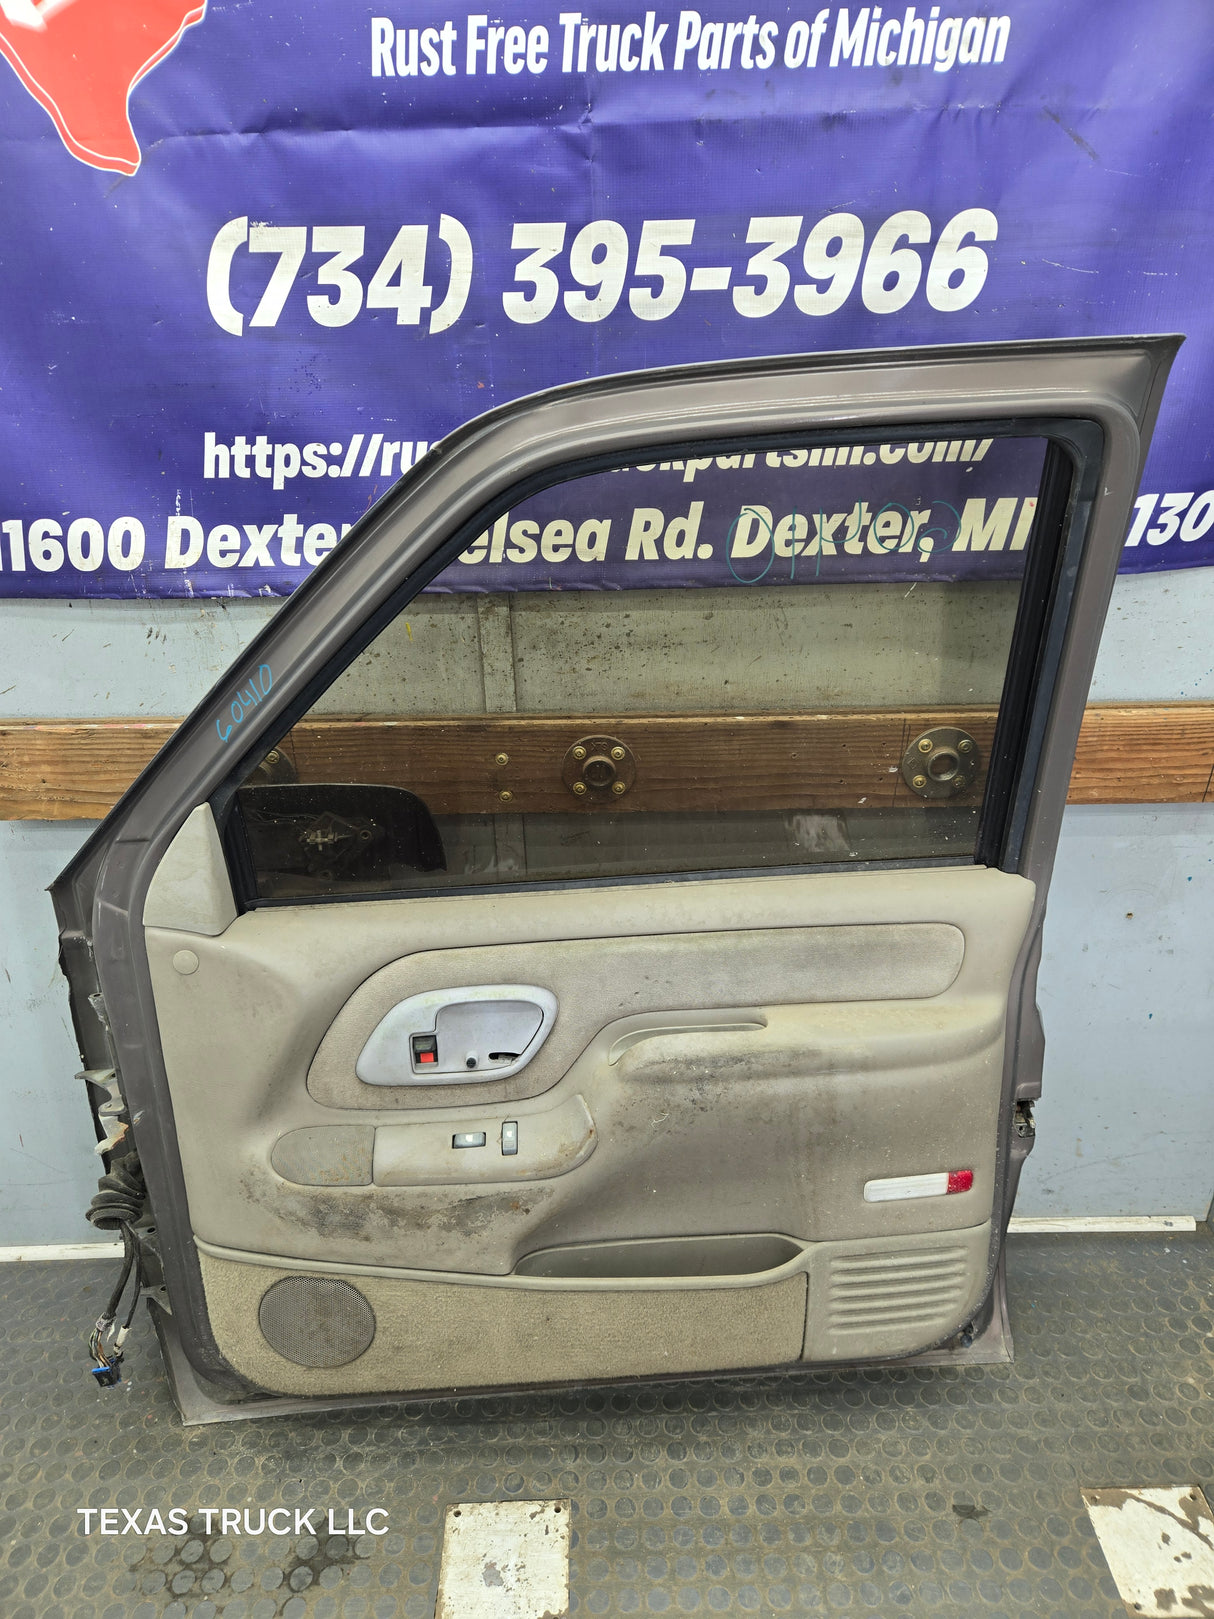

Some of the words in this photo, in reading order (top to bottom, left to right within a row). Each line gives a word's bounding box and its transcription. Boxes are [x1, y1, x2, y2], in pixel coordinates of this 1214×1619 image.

[371, 17, 457, 77] Rust
[466, 14, 549, 75] Free
[559, 11, 669, 73] Truck
[673, 10, 779, 70] Parts
[783, 8, 830, 69] of
[829, 6, 1011, 72] Michigan
[206, 213, 473, 336] (734)
[502, 207, 999, 325] 395-3966
[204, 432, 440, 490] https://ru
[0, 516, 145, 572] 1600
[457, 511, 612, 564] elsea
[624, 501, 714, 561] Rd.
[730, 502, 932, 562] Dexter,
[951, 497, 1039, 552] MI
[1124, 489, 1214, 547] 130
